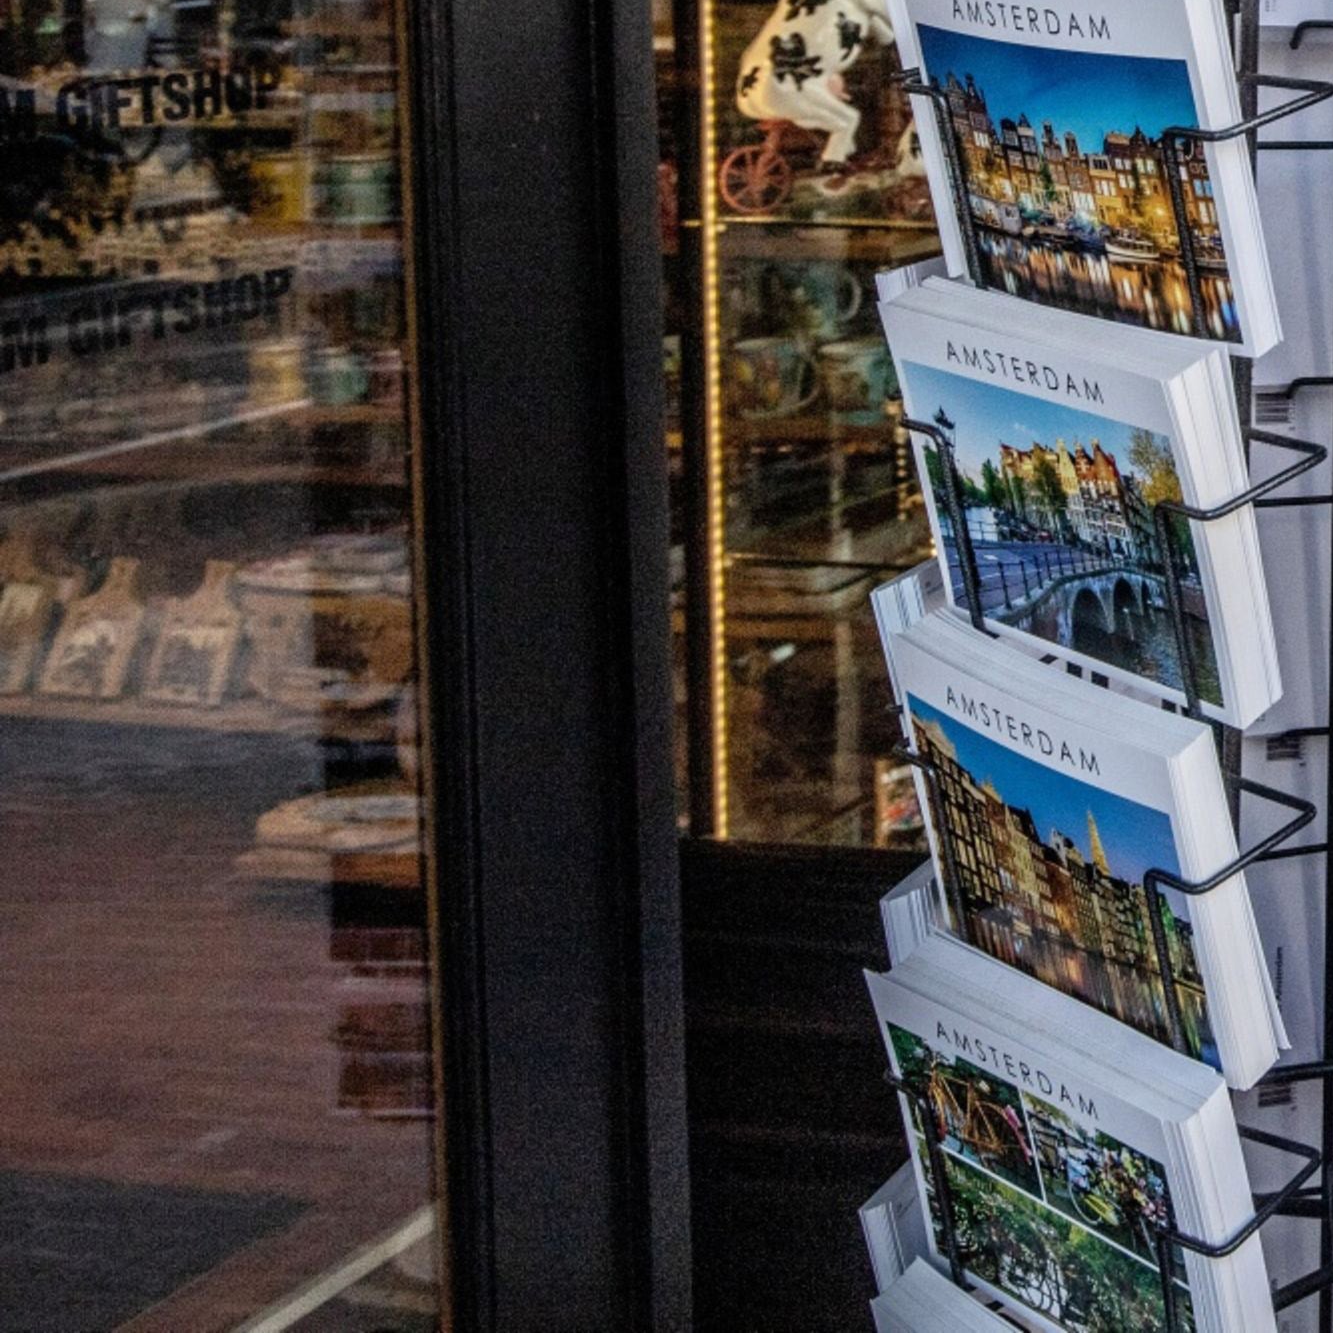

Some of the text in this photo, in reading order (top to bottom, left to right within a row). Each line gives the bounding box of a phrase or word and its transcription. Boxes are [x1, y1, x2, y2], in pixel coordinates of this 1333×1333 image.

[56, 67, 281, 128] GIFTSHOP
[946, 339, 1105, 405] AMSTERDAM
[946, 685, 1101, 776] AMSTERDAM
[936, 1020, 1099, 1120] AMSTERDAM
